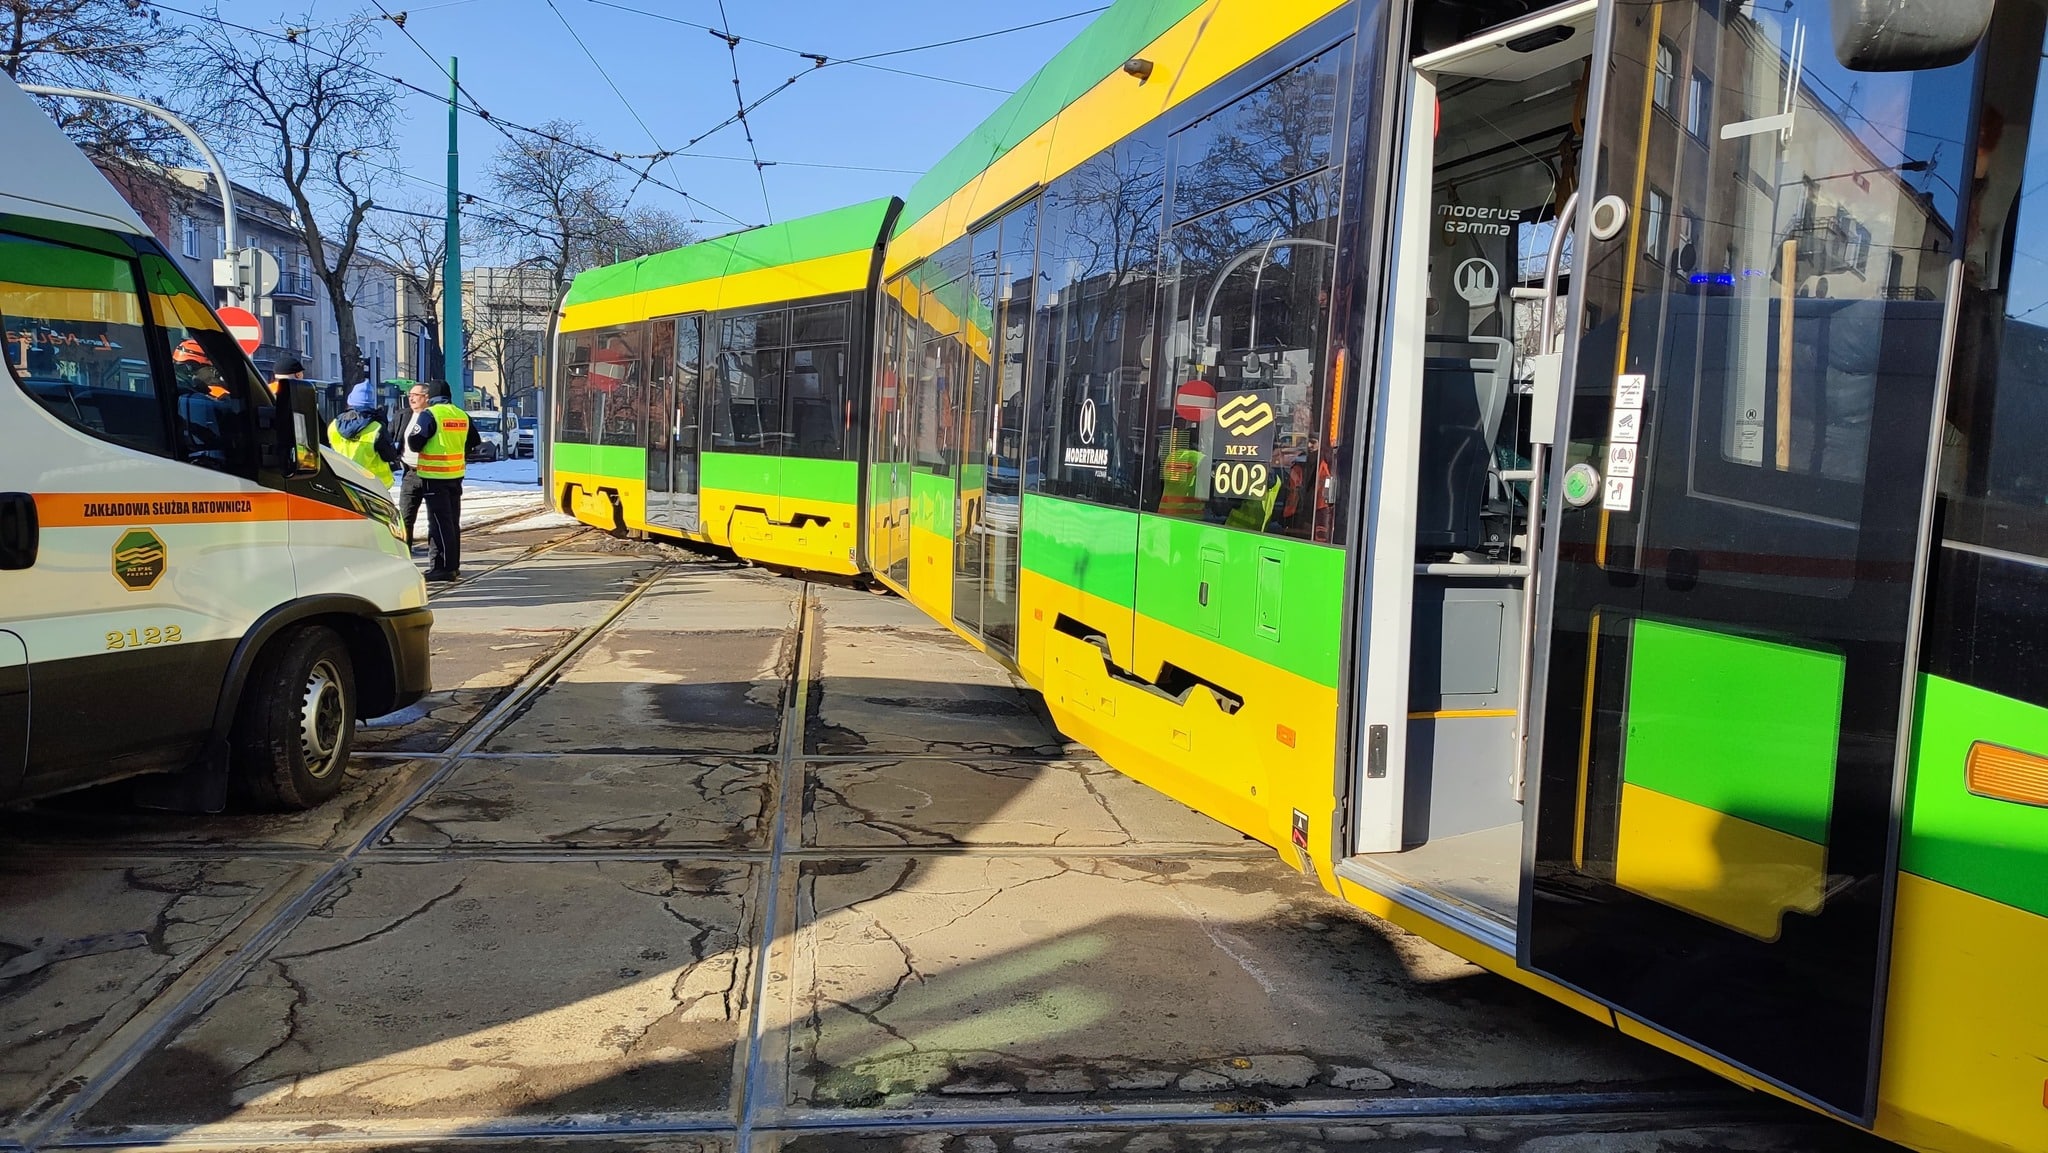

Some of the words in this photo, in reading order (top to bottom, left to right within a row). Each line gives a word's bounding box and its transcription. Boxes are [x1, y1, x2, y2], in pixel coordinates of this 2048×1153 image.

[1065, 447, 1108, 465] MODERTRANS
[1225, 444, 1259, 456] MPK
[1215, 462, 1267, 497] 602
[83, 502, 150, 518] ZAKŁADOWA
[152, 500, 190, 515] SŁUŻBA
[191, 500, 252, 514] RATOWNICZA
[105, 624, 182, 650] 2122
